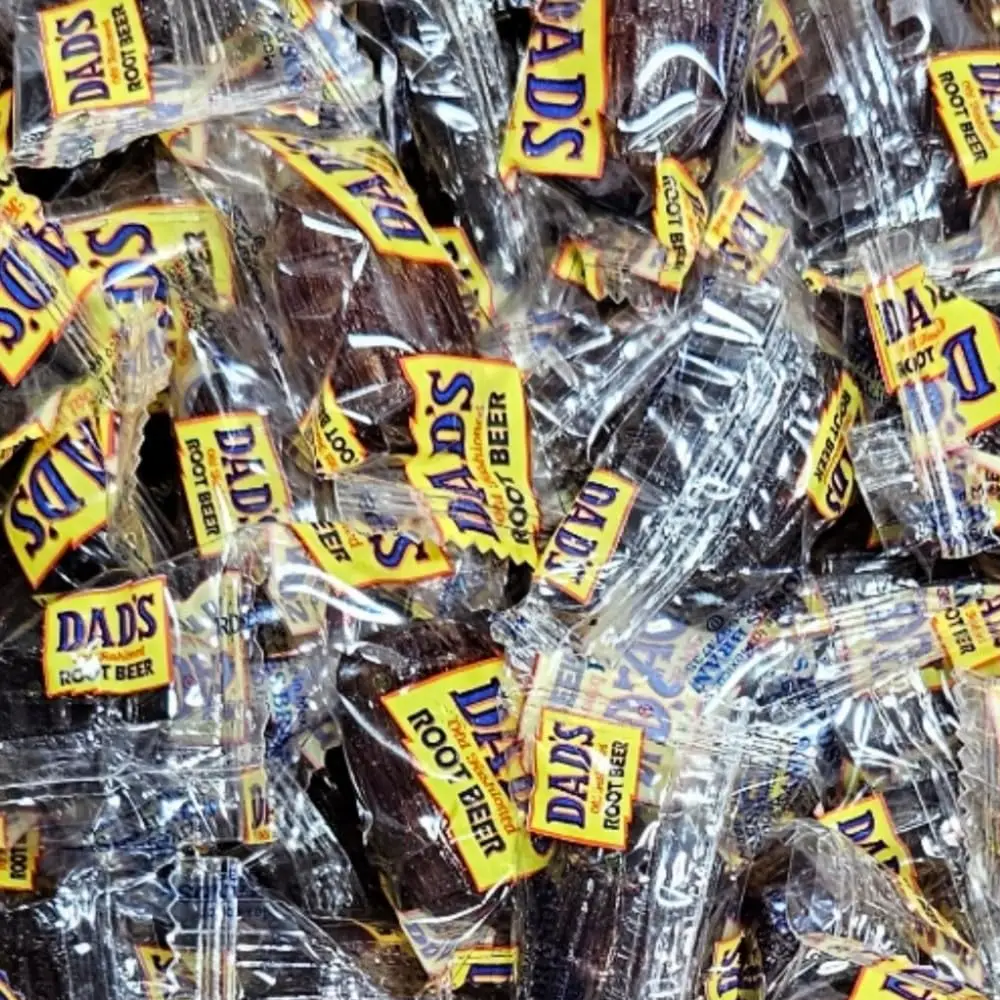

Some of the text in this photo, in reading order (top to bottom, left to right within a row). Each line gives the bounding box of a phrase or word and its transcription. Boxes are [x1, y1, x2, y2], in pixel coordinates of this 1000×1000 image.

[56, 9, 111, 107] DAD'S
[112, 5, 132, 49] BEER
[120, 51, 144, 92] ROOT
[938, 71, 970, 117] ROOT
[959, 118, 989, 164] BEER
[426, 370, 499, 542] DAD'S
[486, 391, 511, 467] BEER
[10, 417, 108, 553] AD'S
[185, 438, 222, 537] ROOT BEER
[57, 593, 158, 652] DAD'S
[115, 659, 156, 682] BEER
[407, 707, 508, 860] ROOT BEER
[546, 720, 595, 830] DAD'S
[602, 779, 622, 831] ROOT
